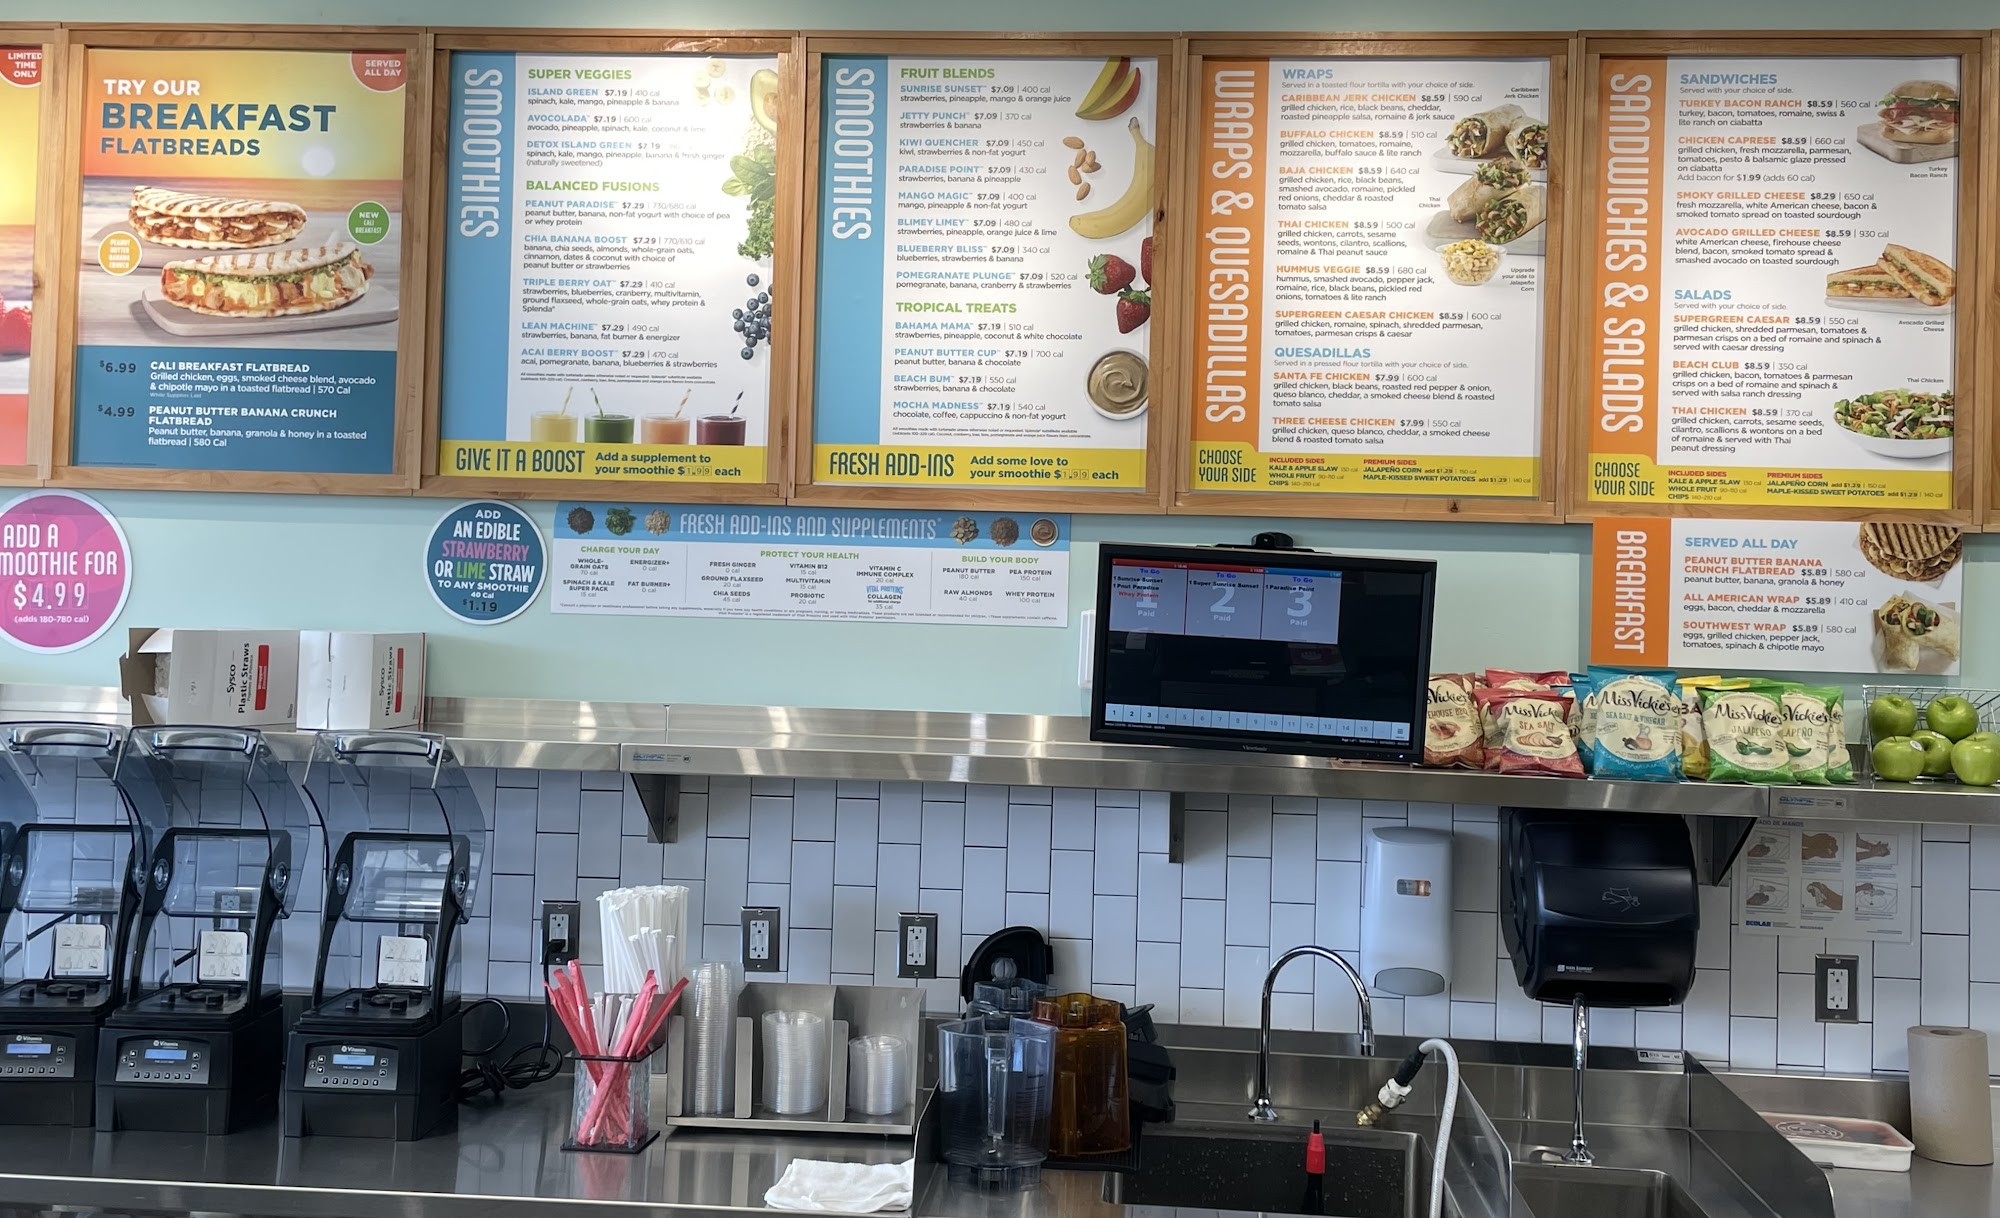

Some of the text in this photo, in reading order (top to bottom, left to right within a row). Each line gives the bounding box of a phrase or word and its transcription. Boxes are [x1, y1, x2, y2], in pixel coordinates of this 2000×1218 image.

[7, 52, 43, 60] LIMITED
[14, 61, 36, 69] TIME
[365, 59, 403, 69] SERVED
[13, 70, 37, 78] ONLY
[364, 68, 401, 76] ALL DAY
[528, 68, 631, 80] SUPER VEGGIES
[900, 67, 995, 78] FRUIT BLENDS
[1282, 68, 1333, 79] WRAPS
[1680, 73, 1777, 85] SANDWICHES
[103, 79, 200, 96] TRY OUR
[102, 102, 337, 132] BREAKFAST
[899, 121, 982, 129] strawberries & banana
[1280, 130, 1326, 138] BUFFALO
[1329, 130, 1374, 138] CHICKEN
[1378, 130, 1404, 139] $8.59
[1411, 131, 1425, 139] 510
[101, 137, 260, 156] FLATBREADS
[899, 138, 922, 146] KIWI
[924, 138, 978, 147] QUENCHER
[985, 139, 1009, 148] $7.09
[1016, 139, 1032, 147] 450
[460, 68, 503, 239] SMOOTHIES
[832, 67, 876, 240] SMOOTHIES
[1689, 164, 1722, 172] ciabatta
[525, 180, 659, 192] BALANCED FUSIONS
[1308, 203, 1327, 211] salsa
[1205, 70, 1255, 423] WRAPS & QUESADILLAS
[1600, 73, 1652, 433] SANDWICHES & SALADS
[1674, 289, 1732, 300] SALADS
[895, 302, 1017, 313] TROPICAL TREATS
[1274, 347, 1371, 358] QUESADILLAS
[99, 360, 136, 373] $6.99
[150, 361, 310, 372] CALI BREAKFAST FLATBREAD
[1672, 360, 1708, 369] BEACH
[1711, 361, 1739, 369] CLUB
[1744, 362, 1770, 370] $8.59
[1778, 362, 1794, 370] 350
[98, 404, 135, 417] $4.99
[149, 406, 337, 419] PEANUT BUTTER BANANA CRUNCH
[148, 417, 212, 426] FLATBREAD
[148, 436, 227, 446] flatbread 580 Cal
[456, 447, 585, 473] GIVE IT A BOOST
[595, 452, 619, 461] Add
[630, 452, 696, 464] supplement
[699, 454, 711, 463] to
[970, 455, 1068, 466] Add some love to
[1199, 449, 1243, 465] CHOOSE
[829, 451, 954, 477] FRESH ADD-INS
[1594, 461, 1640, 478] CHOOSE
[1198, 466, 1256, 482] YOUR SIDE
[1594, 479, 1655, 496] YOUR SIDE
[475, 509, 501, 519] ADD
[680, 513, 724, 534] FRESH
[730, 513, 791, 536] ADD-INS
[796, 517, 826, 537] AND
[3, 524, 58, 548] ADD A
[453, 522, 521, 541] AN EDIBLE
[1685, 537, 1798, 549] SERVED ALL DAY
[441, 539, 530, 562] STRAWBERRY
[580, 545, 615, 553] CHARGE
[617, 546, 641, 554] YOUR
[760, 550, 859, 560] PROTECT YOUR HEALTH
[0, 551, 117, 576] MOOTHIE FOR
[961, 555, 987, 563] BUILD
[434, 559, 535, 583] OR LIME STRAW
[437, 579, 529, 593] TO ANY SMOOTHIE
[1614, 530, 1647, 654] BREAKFAST
[13, 580, 85, 610] $4.99
[1683, 593, 1868, 606] ALL AMERICAN WRAP $5.89 410 cal
[1286, 587, 1313, 618] 3
[1683, 603, 1826, 614] eggs, bacon, cheddar & mozzarella
[14, 615, 89, 623] (adds 180-780 cal)
[1213, 614, 1231, 622] Paid
[1290, 618, 1308, 626] Paid
[226, 664, 237, 693] Sysco
[238, 642, 250, 714] Plastic Straws
[1600, 690, 1632, 707] Miss
[1605, 711, 1618, 719] SEA
[1618, 712, 1632, 720] SALT
[1640, 715, 1665, 725] VINEGAR
[1519, 721, 1555, 730] SEA SALT
